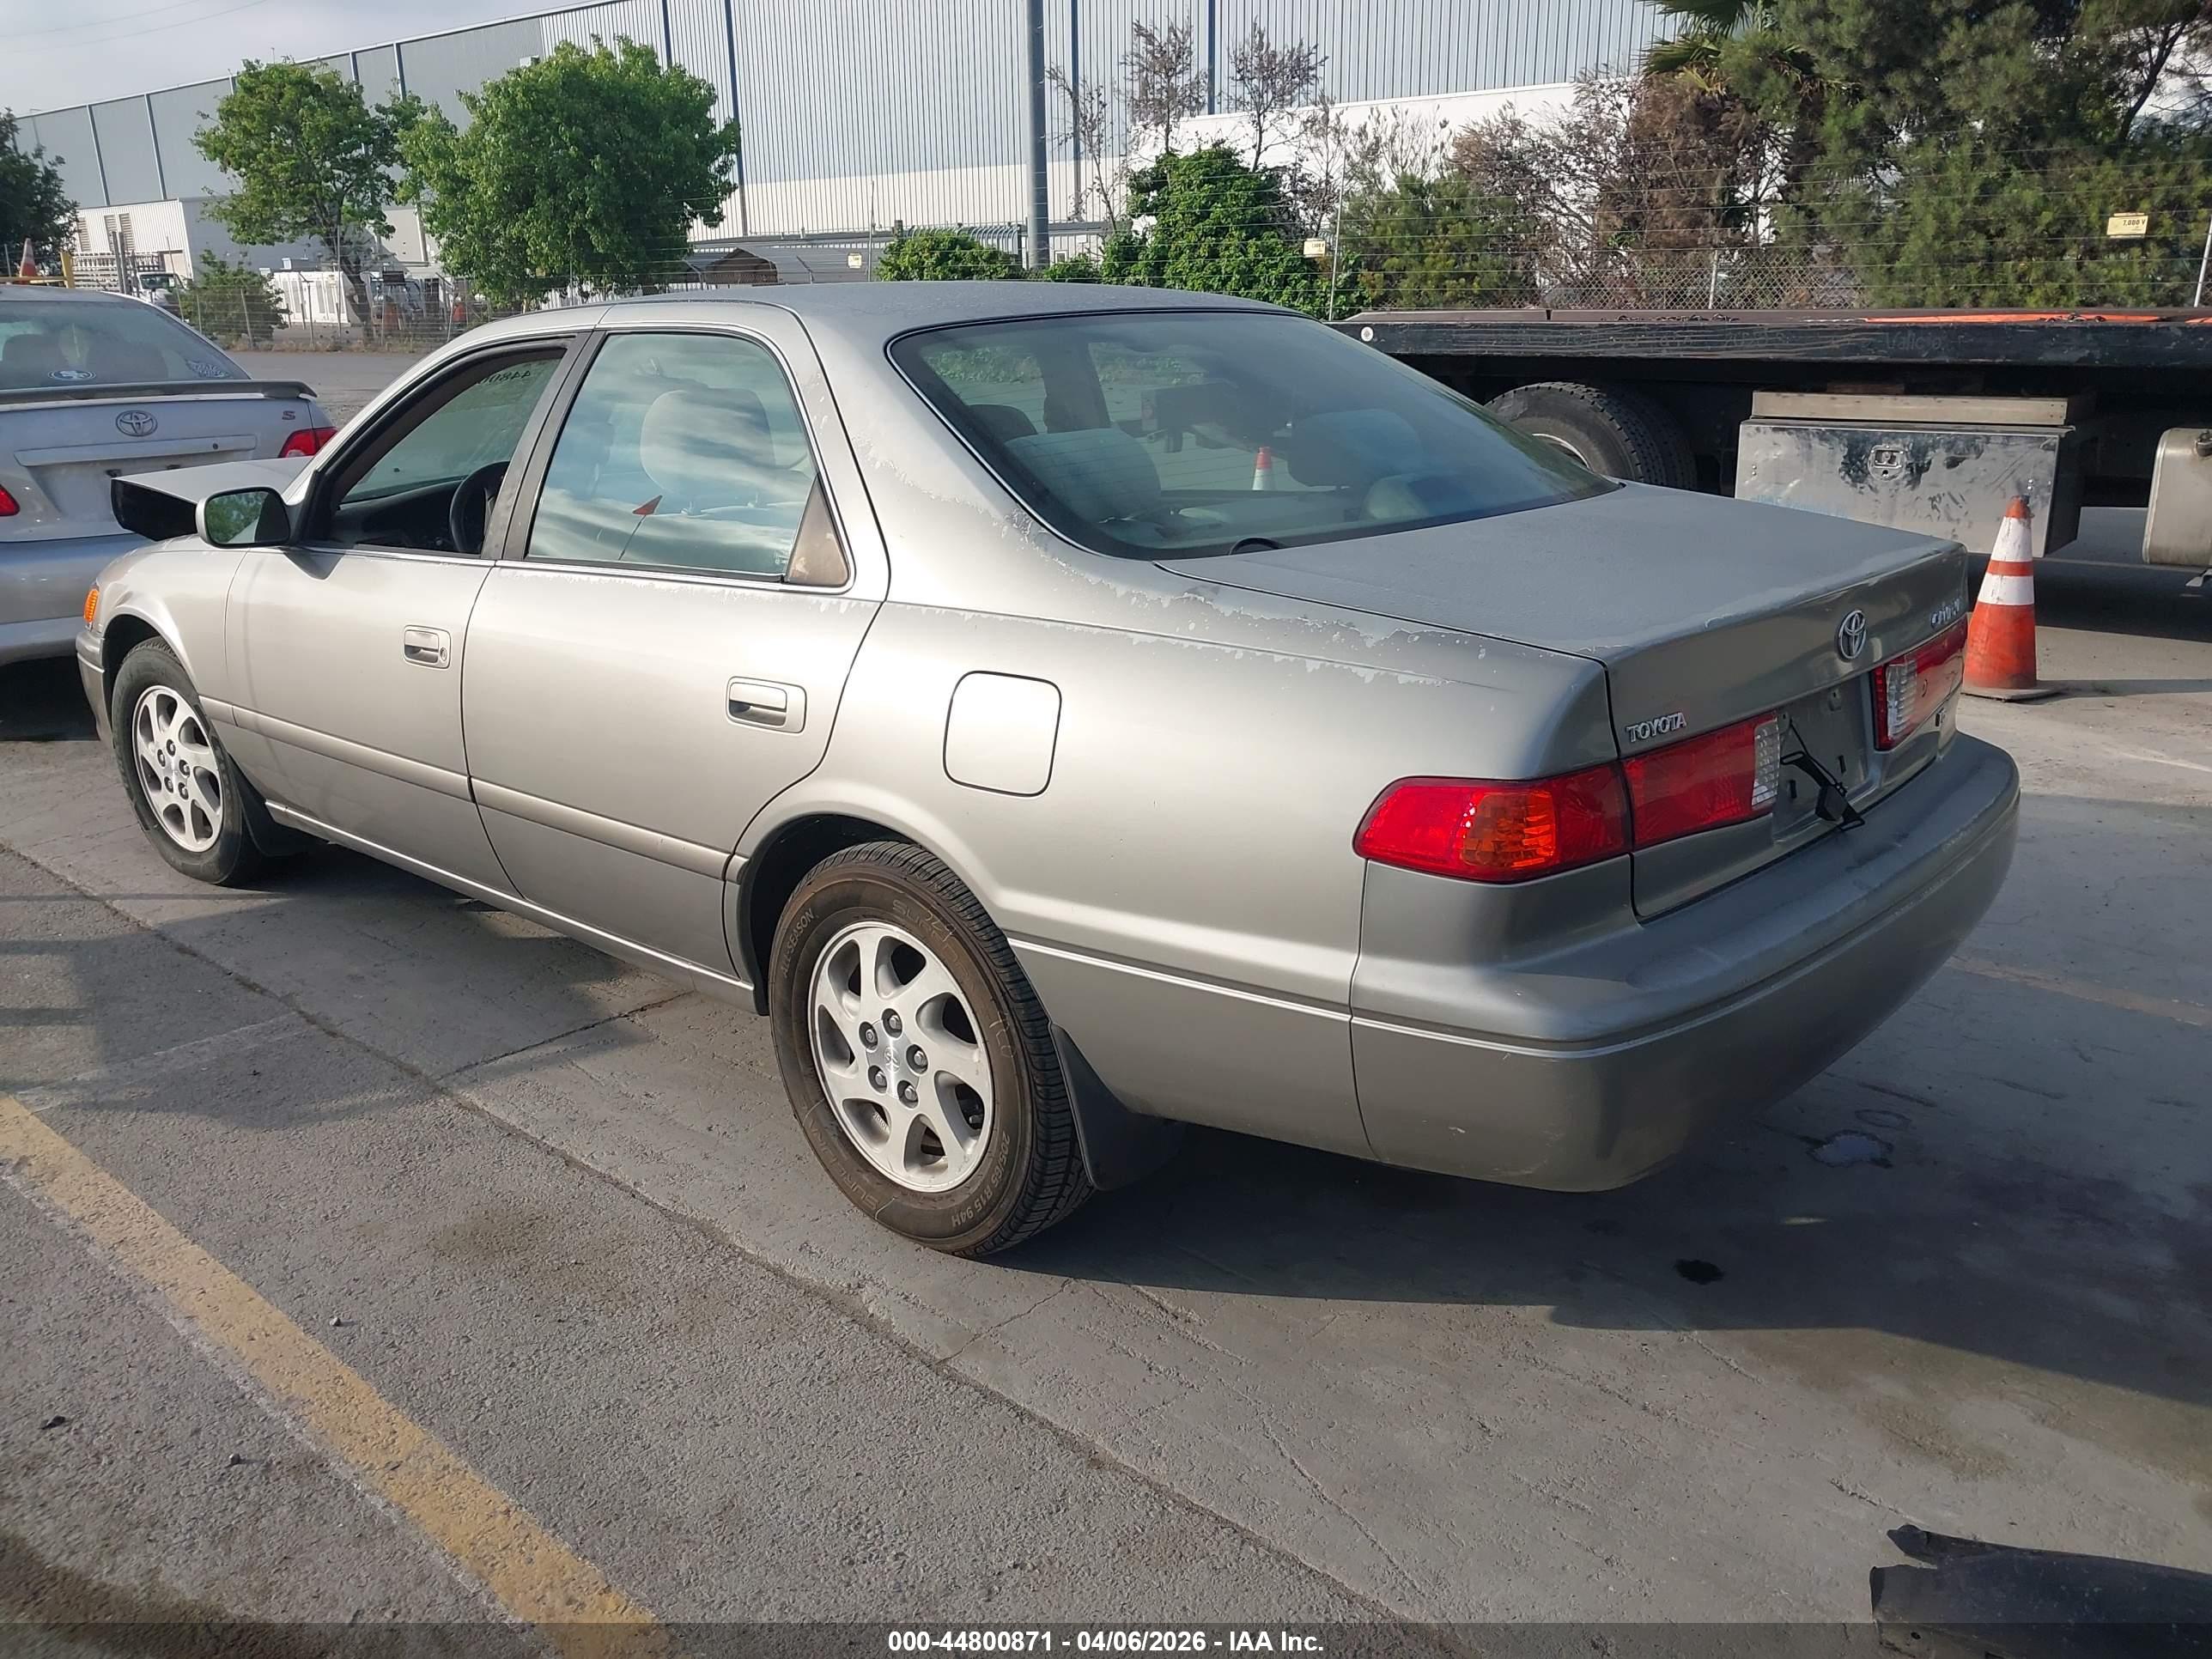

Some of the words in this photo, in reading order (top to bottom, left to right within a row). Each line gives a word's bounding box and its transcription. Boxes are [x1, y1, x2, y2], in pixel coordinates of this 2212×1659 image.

[282, 410, 296, 421] S
[1626, 712, 1687, 743] TOYOTA
[781, 908, 815, 978] ALL-SEASON
[991, 1130, 1011, 1188] 205/65
[974, 1185, 994, 1212] R15
[951, 1207, 974, 1228] 94H
